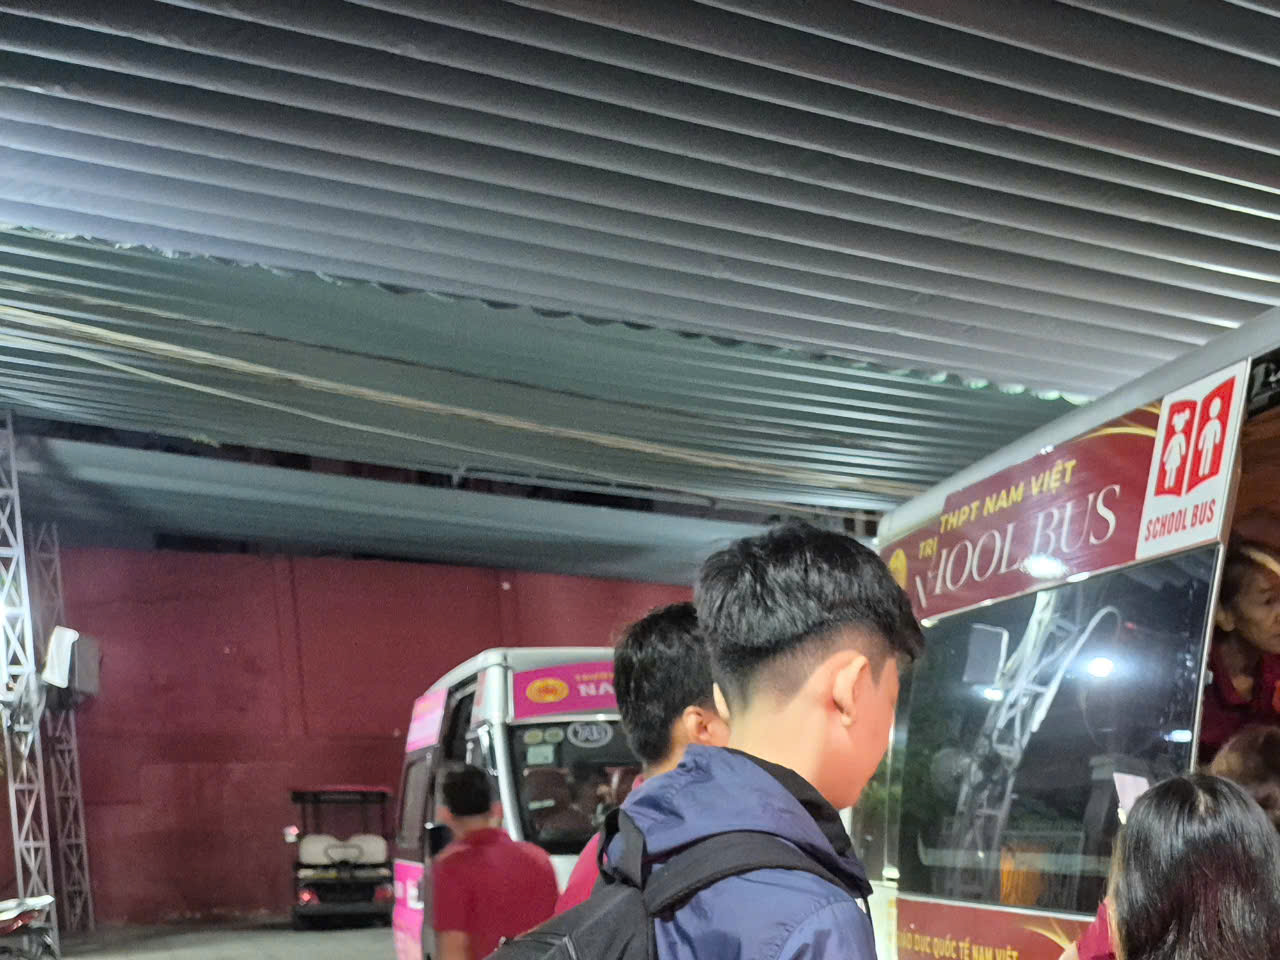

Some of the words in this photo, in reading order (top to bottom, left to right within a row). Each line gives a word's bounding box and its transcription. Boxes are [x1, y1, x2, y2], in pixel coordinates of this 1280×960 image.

[983, 481, 1025, 516] NAM
[1031, 459, 1077, 497] VIỆT
[1144, 507, 1187, 543] SCHOOL
[1191, 498, 1217, 529] BUS
